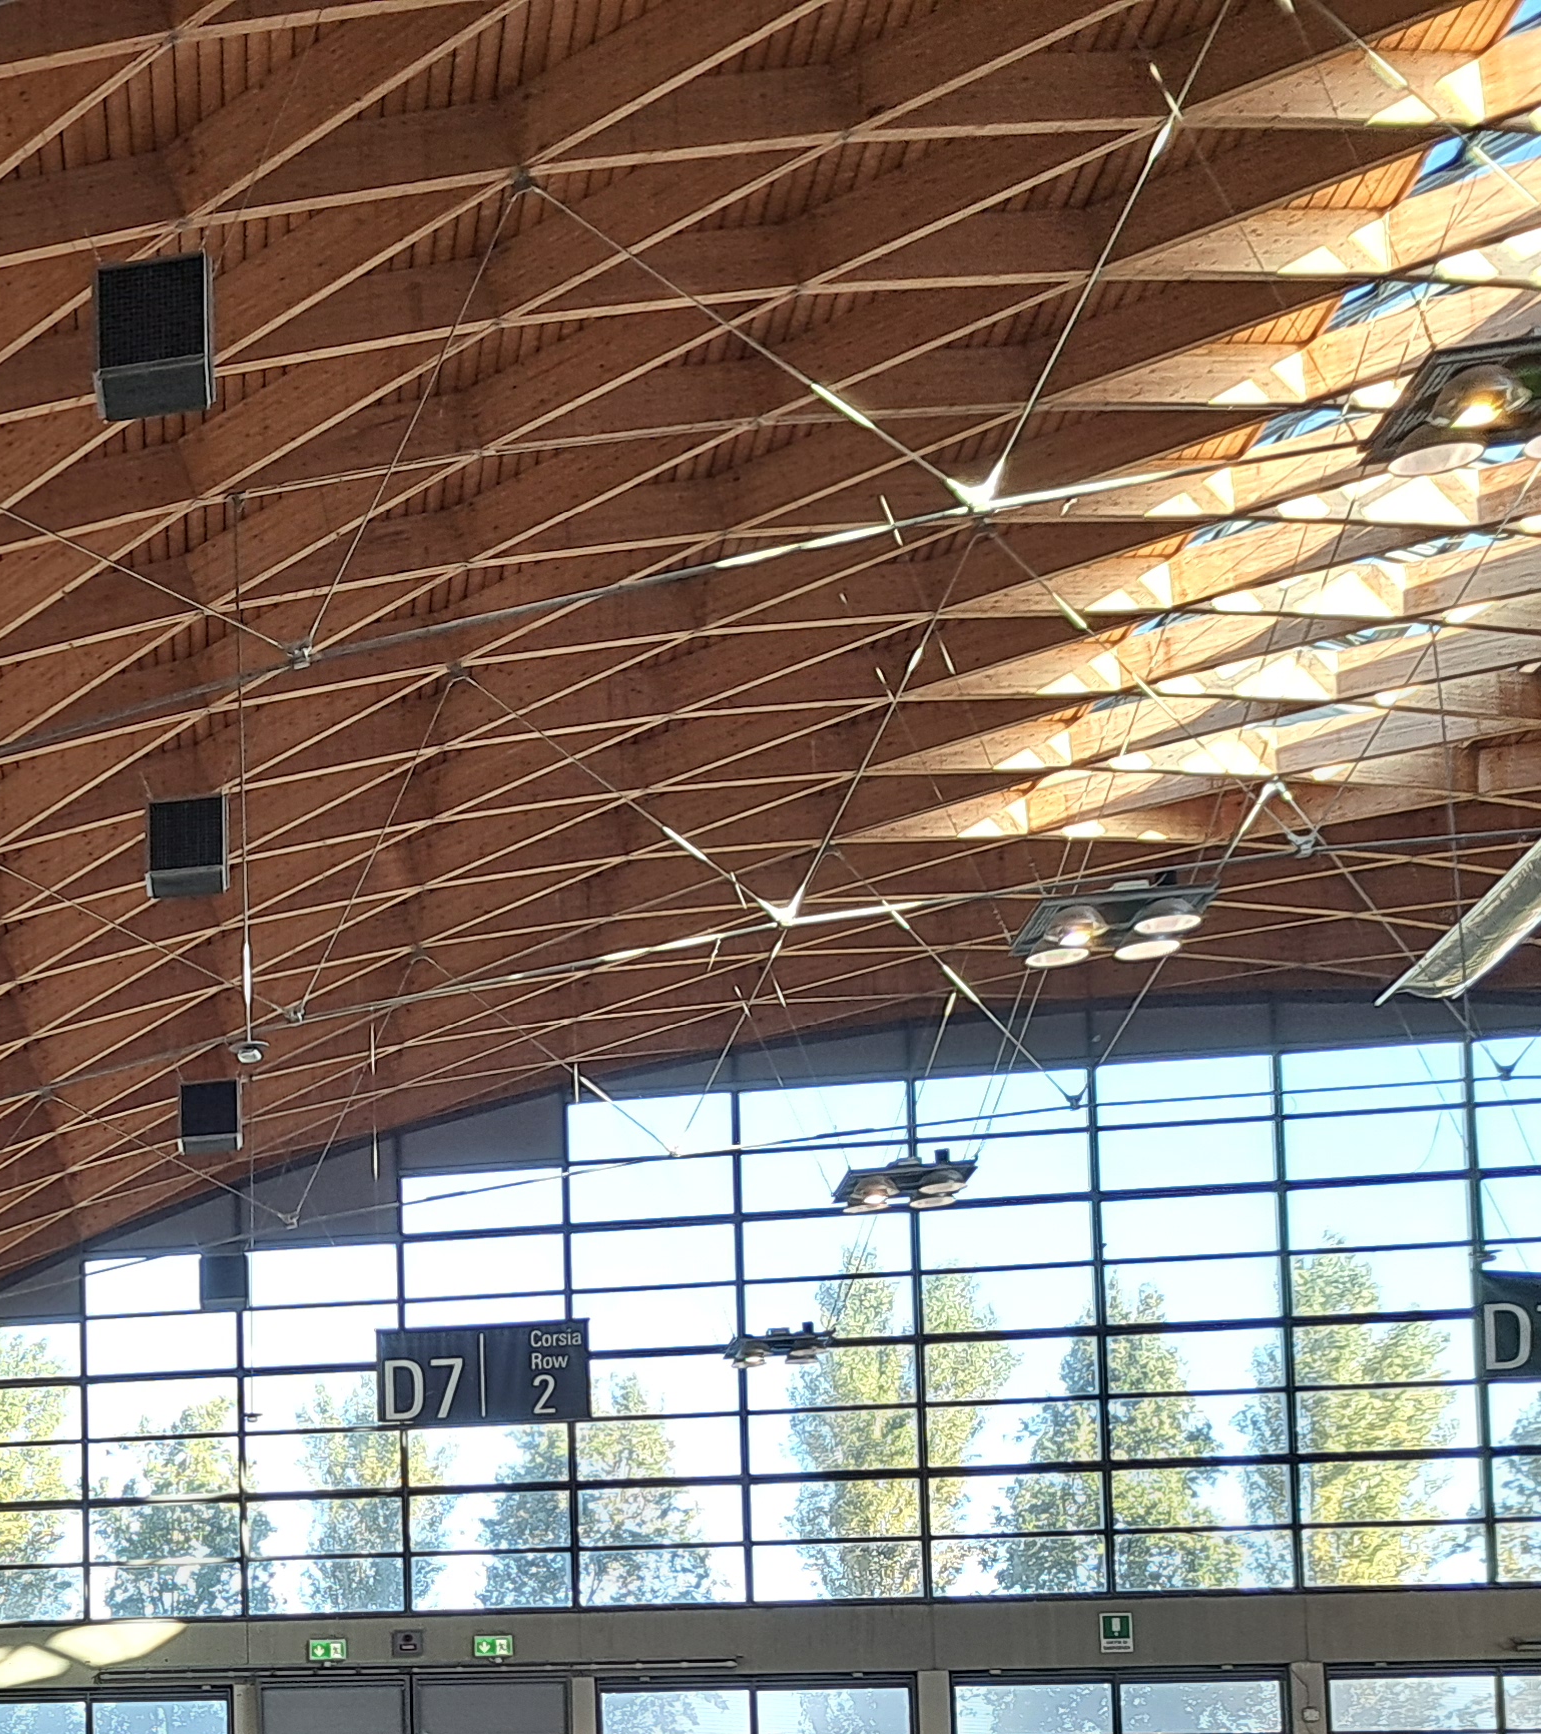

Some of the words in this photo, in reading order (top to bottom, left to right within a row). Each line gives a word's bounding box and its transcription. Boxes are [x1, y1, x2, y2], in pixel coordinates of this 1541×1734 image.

[530, 1329, 583, 1348] Corsia
[1483, 1302, 1541, 1370] D
[530, 1352, 569, 1371] Row
[383, 1356, 464, 1421] D7
[532, 1373, 557, 1415] 2
